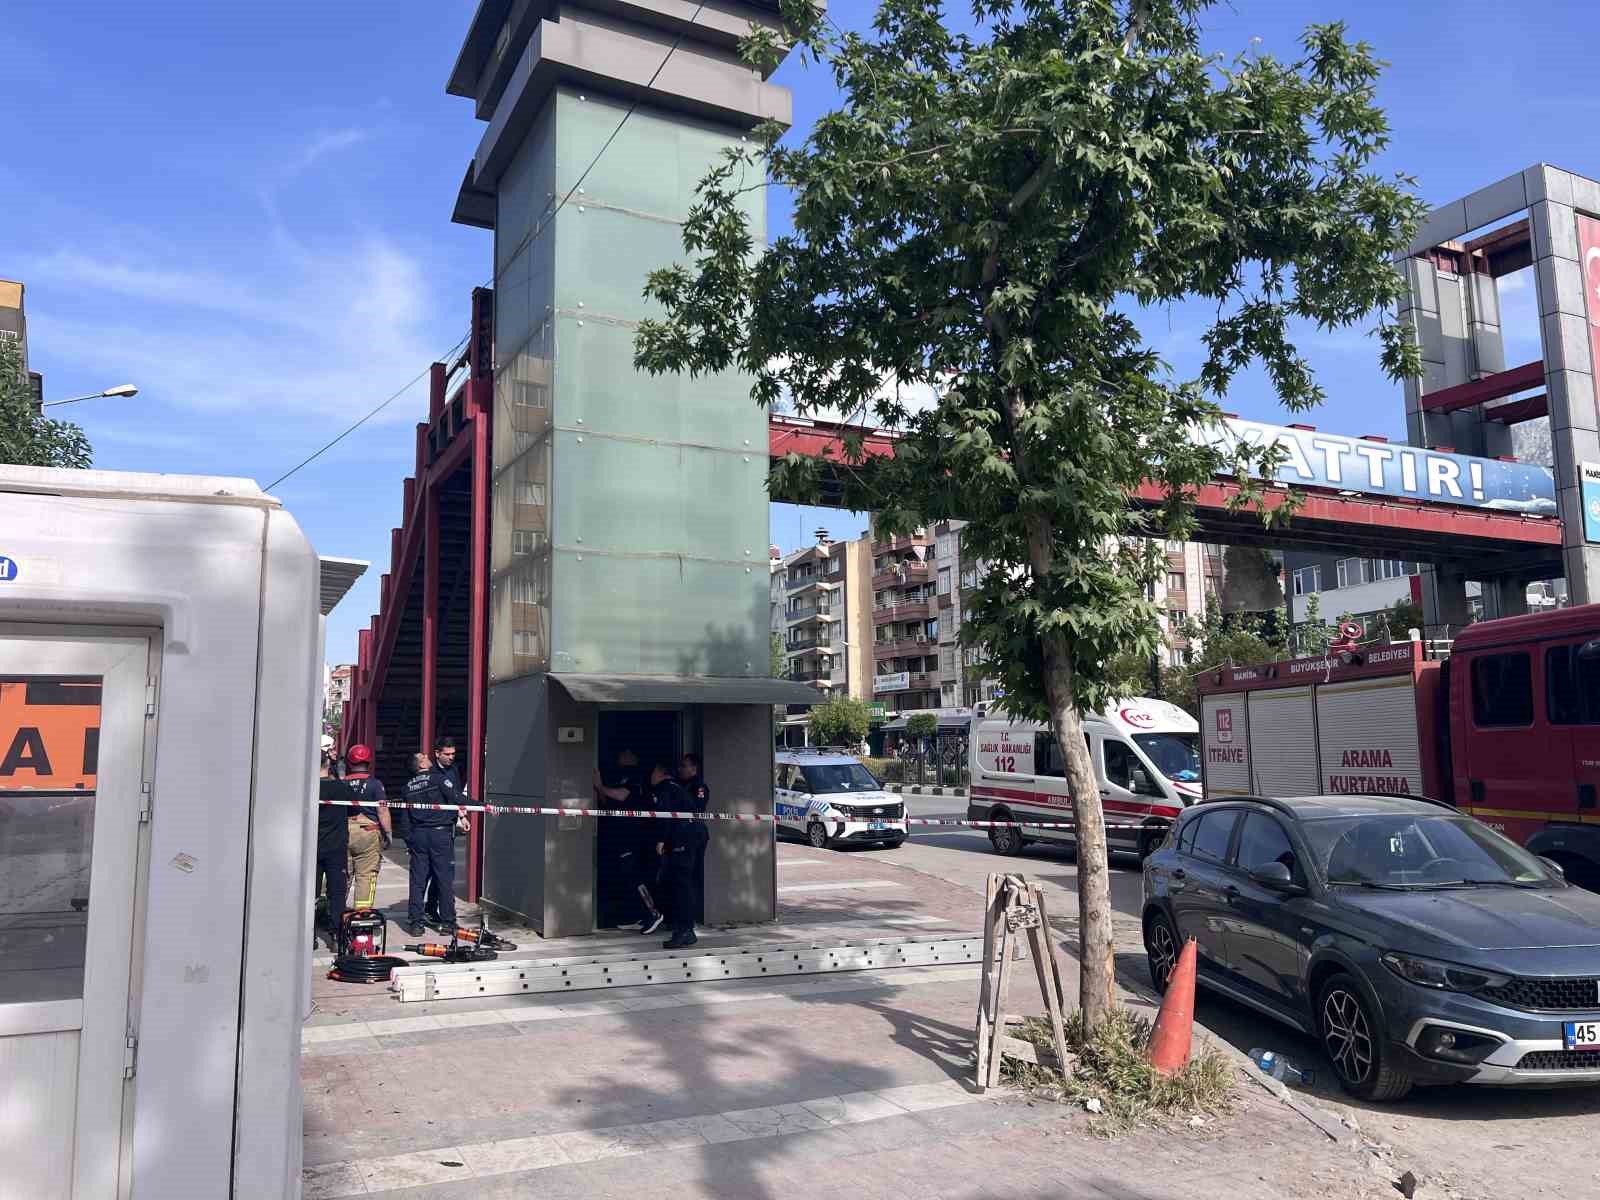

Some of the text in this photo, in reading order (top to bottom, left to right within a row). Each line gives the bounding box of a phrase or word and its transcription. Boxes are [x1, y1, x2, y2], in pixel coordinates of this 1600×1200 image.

[1368, 646, 1410, 664] BELEDİYESİ
[1129, 713, 1153, 722] 112
[1218, 713, 1231, 729] 112
[1208, 745, 1243, 763] İTFAİYE
[1342, 749, 1393, 768] ARAMA
[994, 756, 1016, 773] 112
[1329, 775, 1411, 795] KURTARMA
[1577, 1025, 1597, 1042] 45
